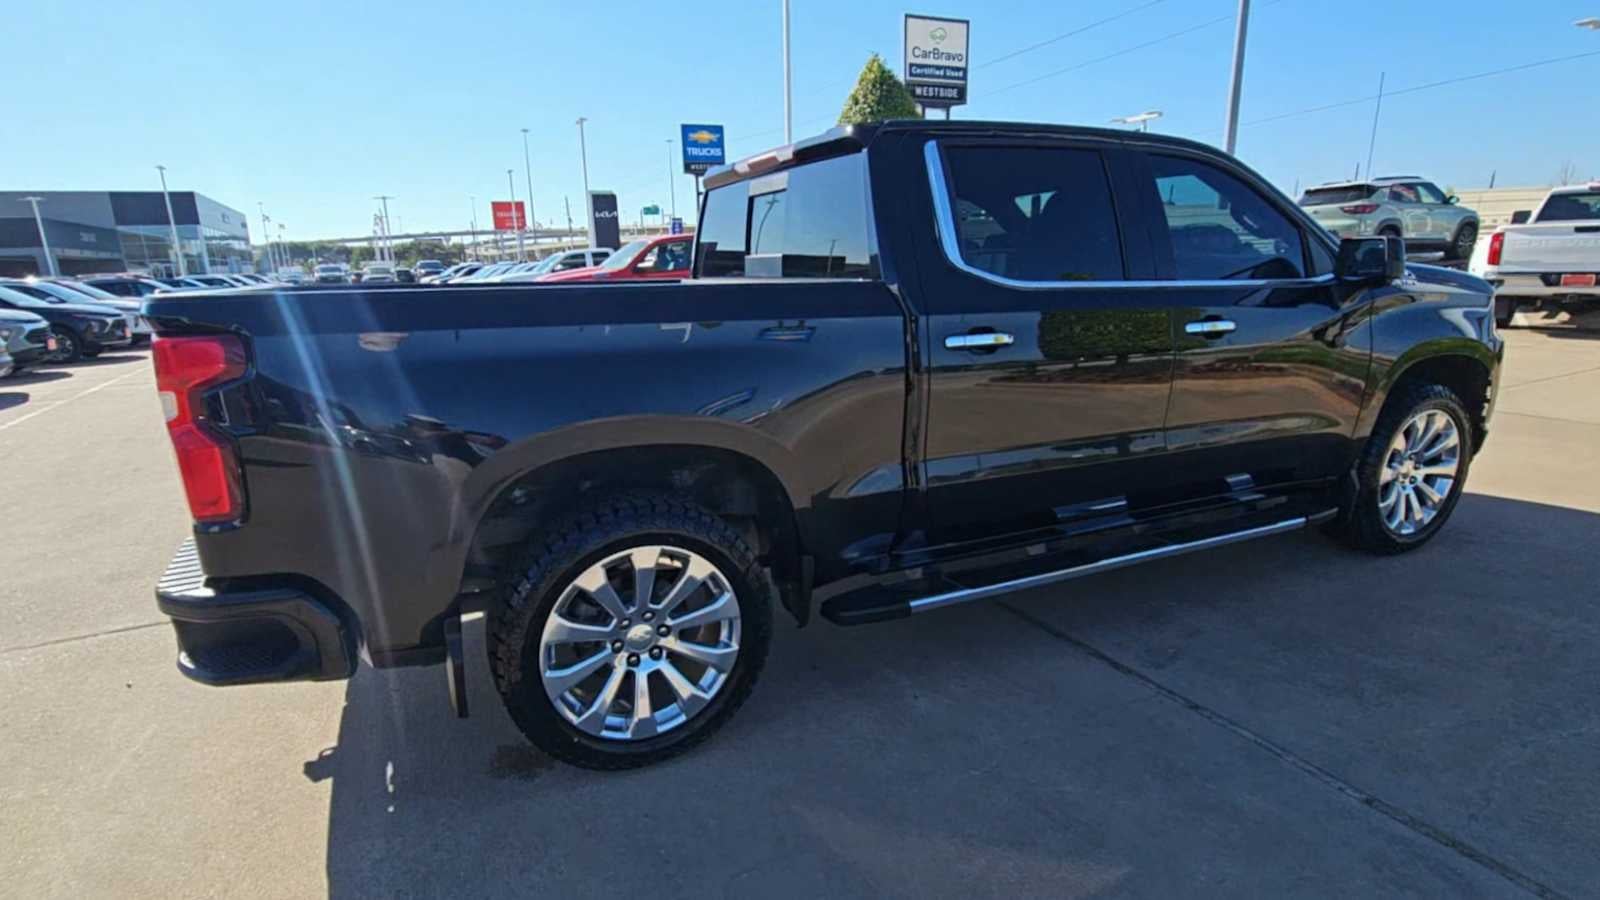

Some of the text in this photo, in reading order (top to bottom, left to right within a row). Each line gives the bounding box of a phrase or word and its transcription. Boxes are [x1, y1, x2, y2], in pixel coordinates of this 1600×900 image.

[911, 46, 964, 62] CarBravo
[911, 65, 964, 77] Certified Used
[915, 86, 959, 98] WESTSIDE
[687, 147, 722, 156] TRUCKS
